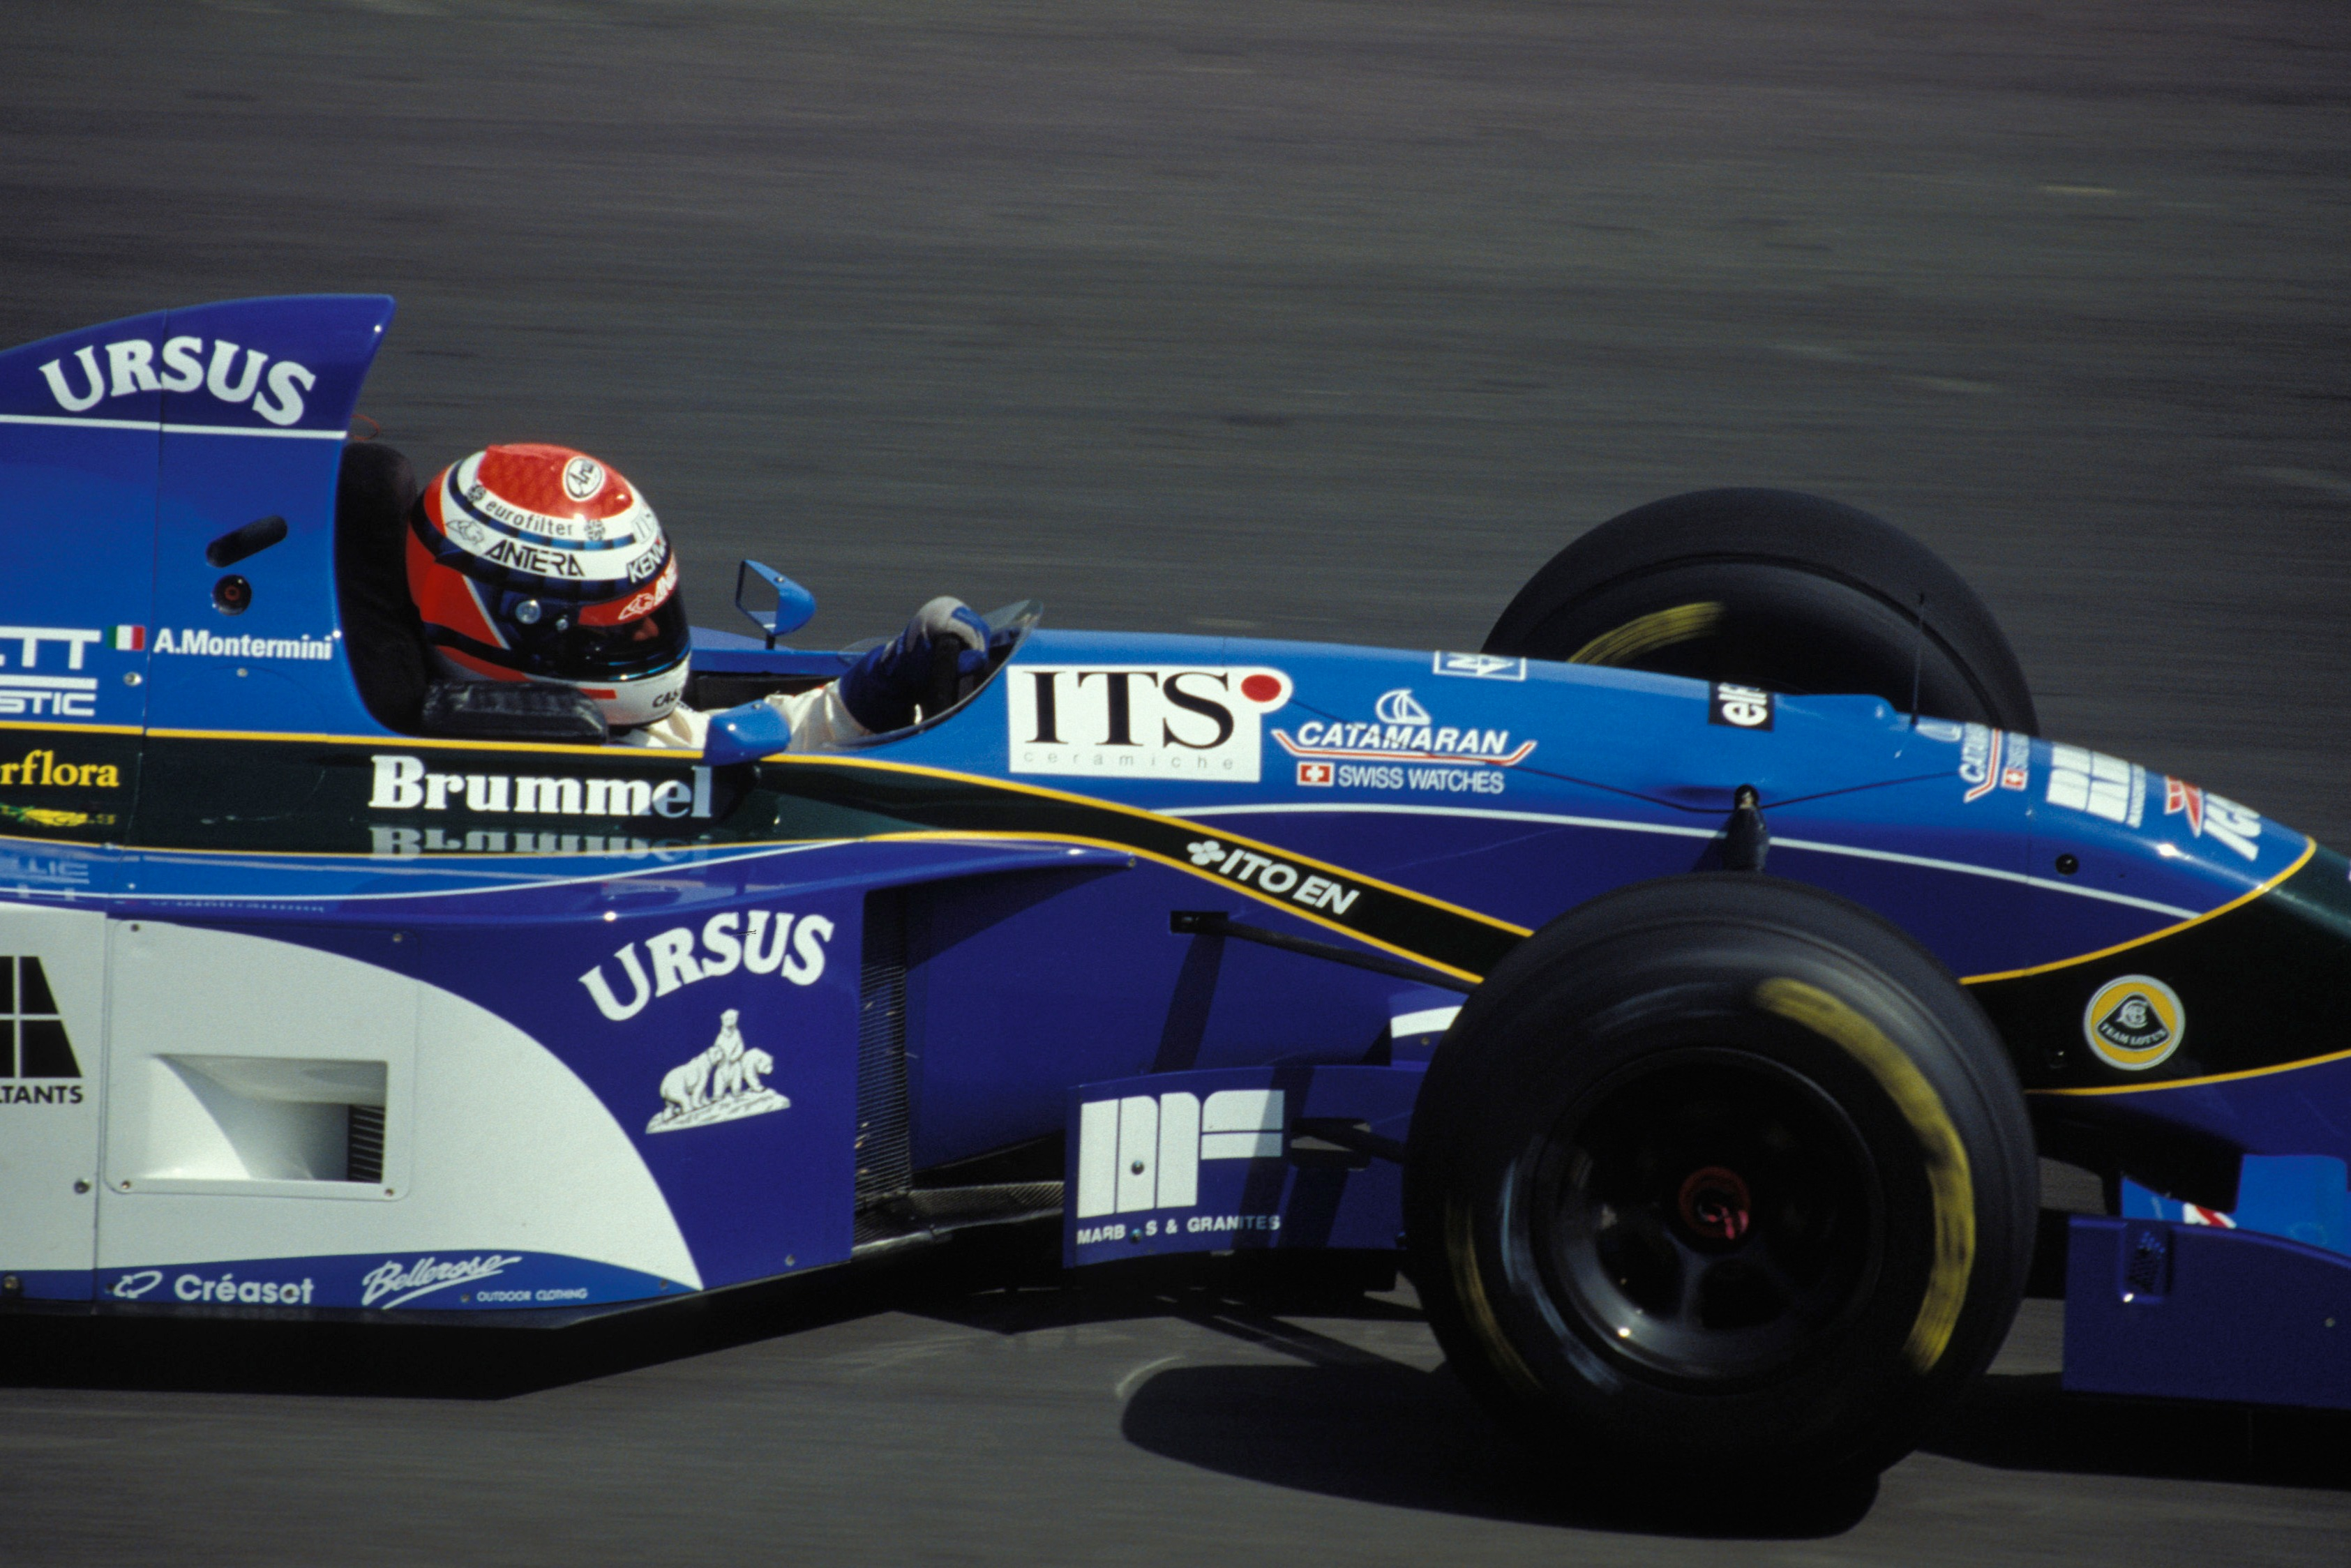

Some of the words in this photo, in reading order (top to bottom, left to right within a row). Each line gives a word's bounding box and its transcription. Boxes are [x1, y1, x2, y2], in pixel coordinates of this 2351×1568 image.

[38, 336, 317, 426] URSUS
[485, 500, 573, 536] eurofilter
[484, 538, 586, 577] ANTERA
[0, 626, 102, 670] TT
[153, 627, 333, 661] A.Montermini
[1023, 671, 1235, 750] ITS
[1297, 721, 1509, 755] CATAMARAN
[0, 748, 120, 787] rflora
[1023, 751, 1234, 770] ceramiche
[1338, 765, 1404, 790] SWISS
[1408, 769, 1505, 794] WATCHES
[368, 755, 714, 819] Brummel
[1219, 848, 1299, 894] ITO
[1293, 874, 1361, 915] EN
[578, 910, 835, 1021] URSUS
[0, 1085, 84, 1104] TANTS
[1076, 1219, 1158, 1245] MARBS
[1165, 1219, 1178, 1235] &
[1187, 1214, 1282, 1233] GRANITES
[361, 1255, 523, 1306] Bellerose
[476, 1290, 532, 1302] OUTDOOR
[535, 1288, 588, 1302] CLOTHING
